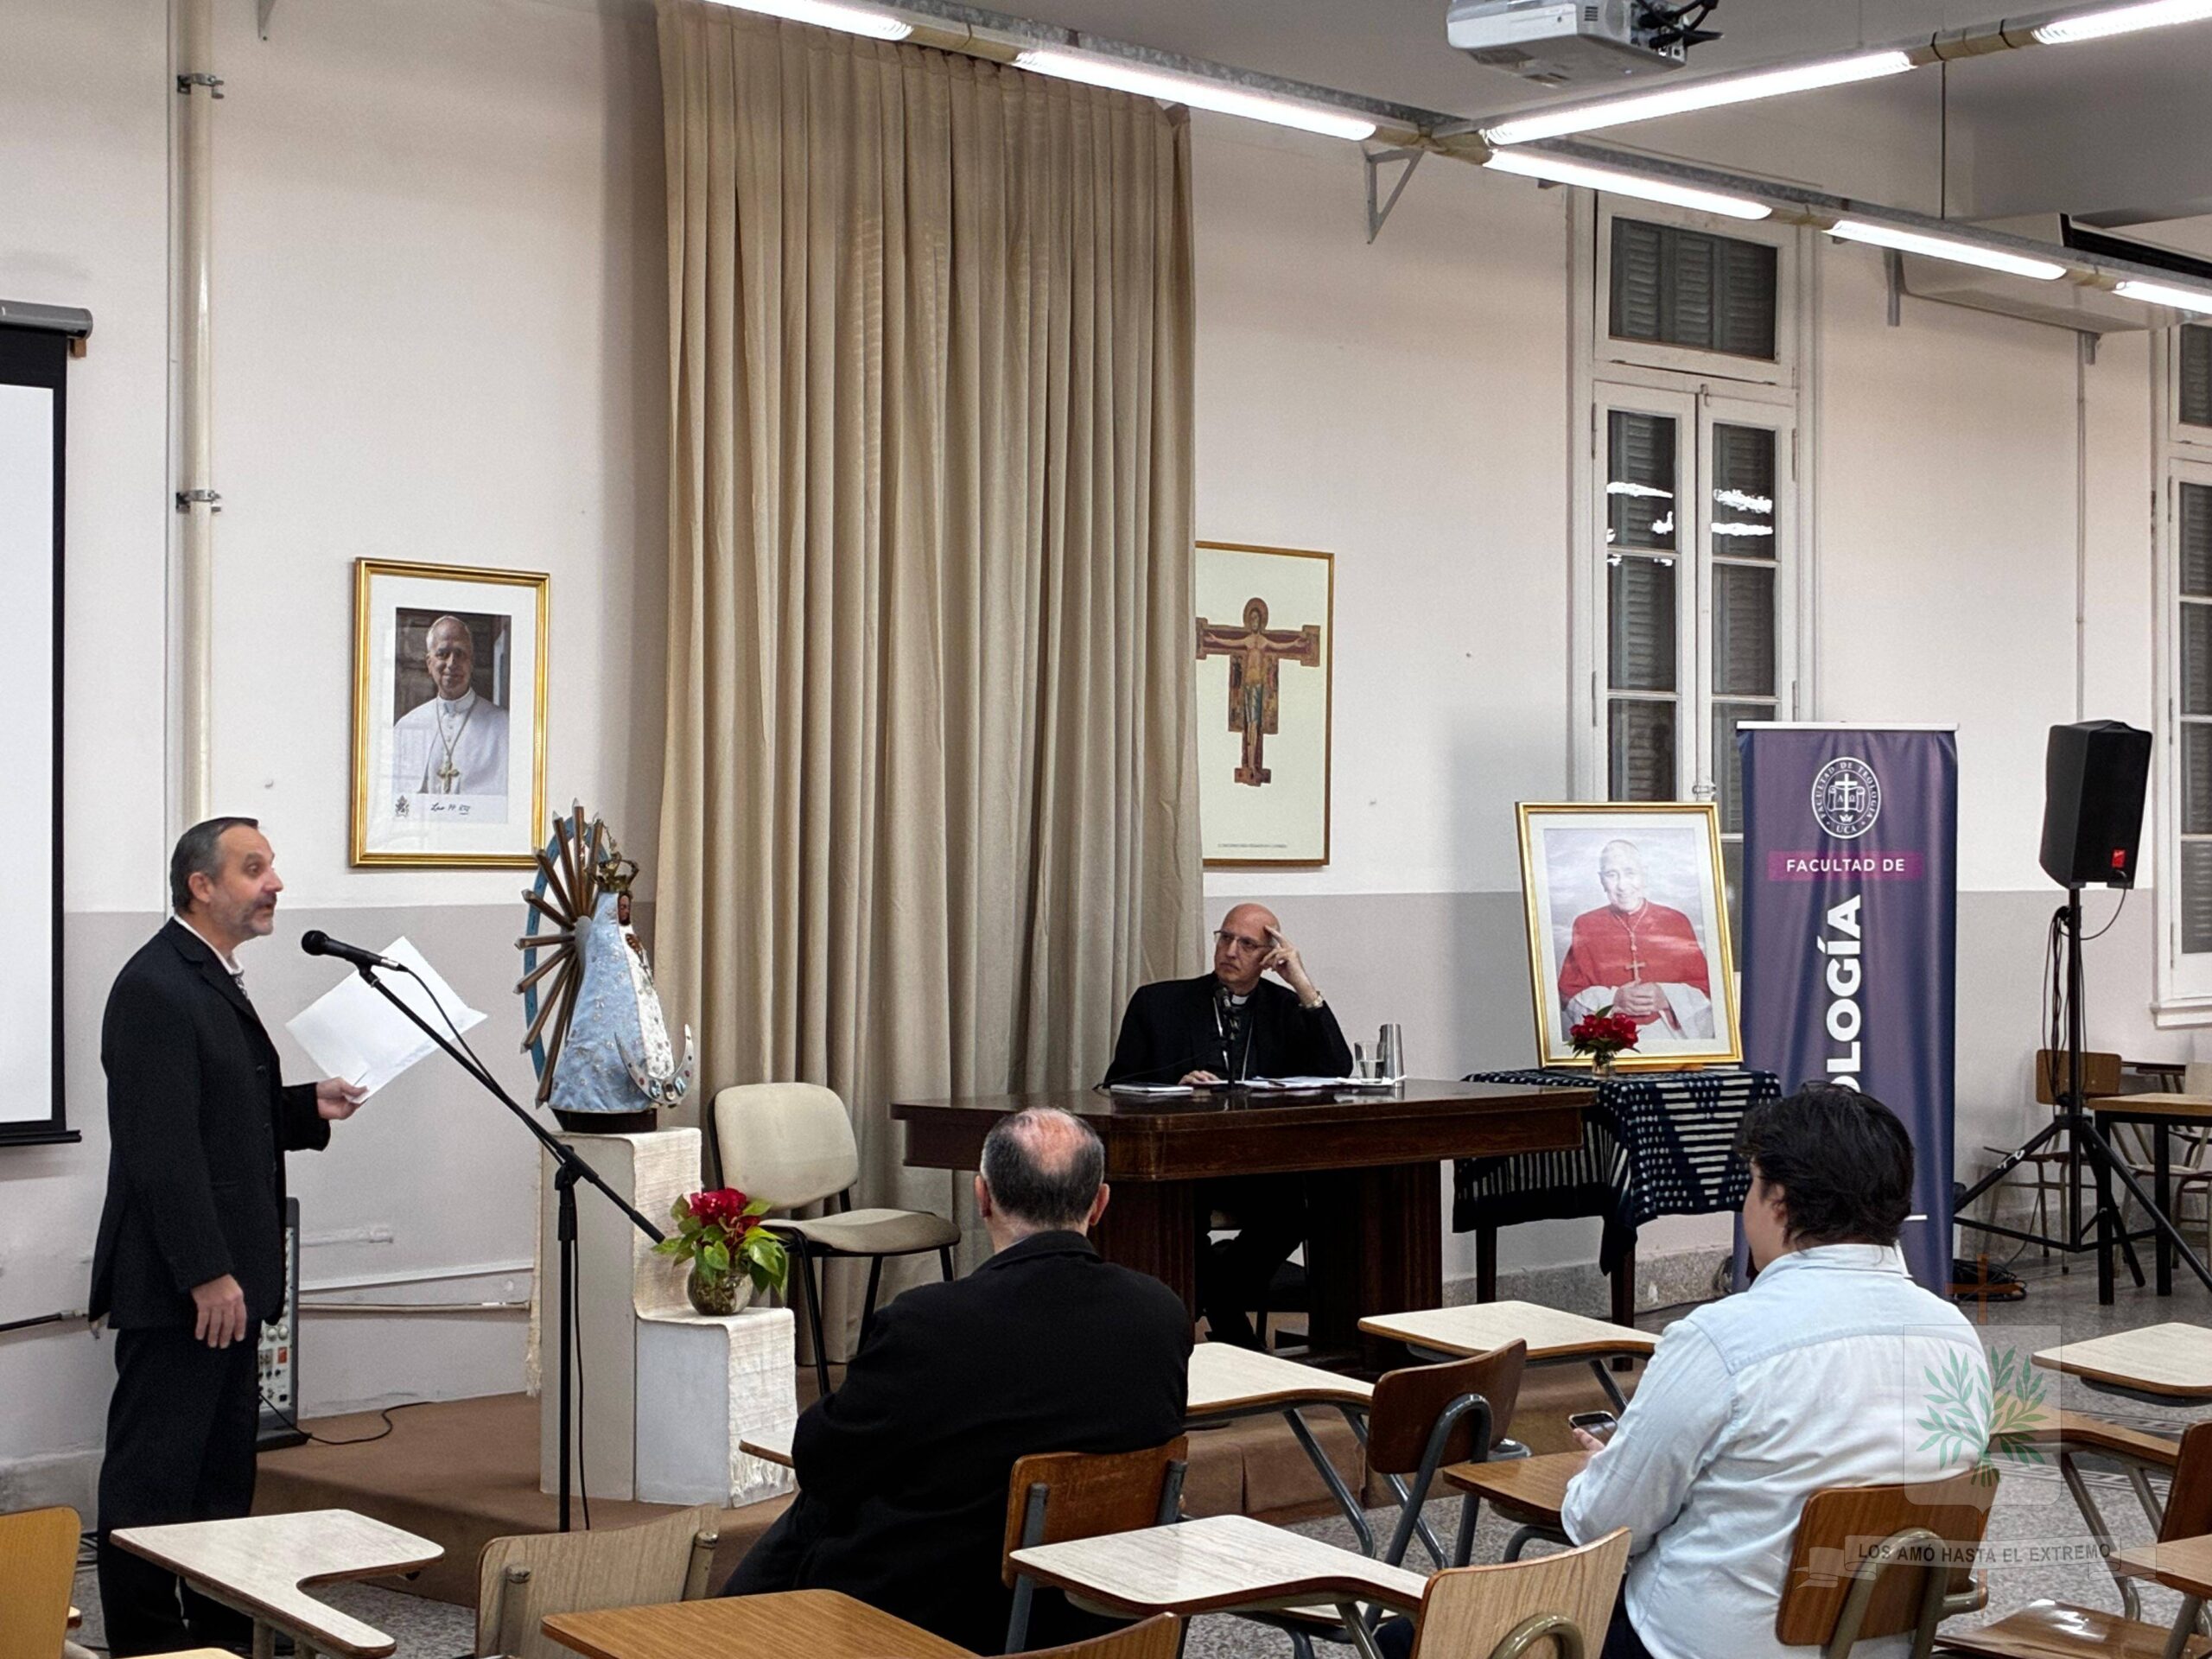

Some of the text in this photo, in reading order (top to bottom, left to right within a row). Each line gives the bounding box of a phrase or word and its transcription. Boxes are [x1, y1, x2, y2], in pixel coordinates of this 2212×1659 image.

[1836, 824, 1857, 834] UCA
[1786, 858, 1905, 873] FACULTAD DE
[1817, 893, 1861, 1095] LOGÍA
